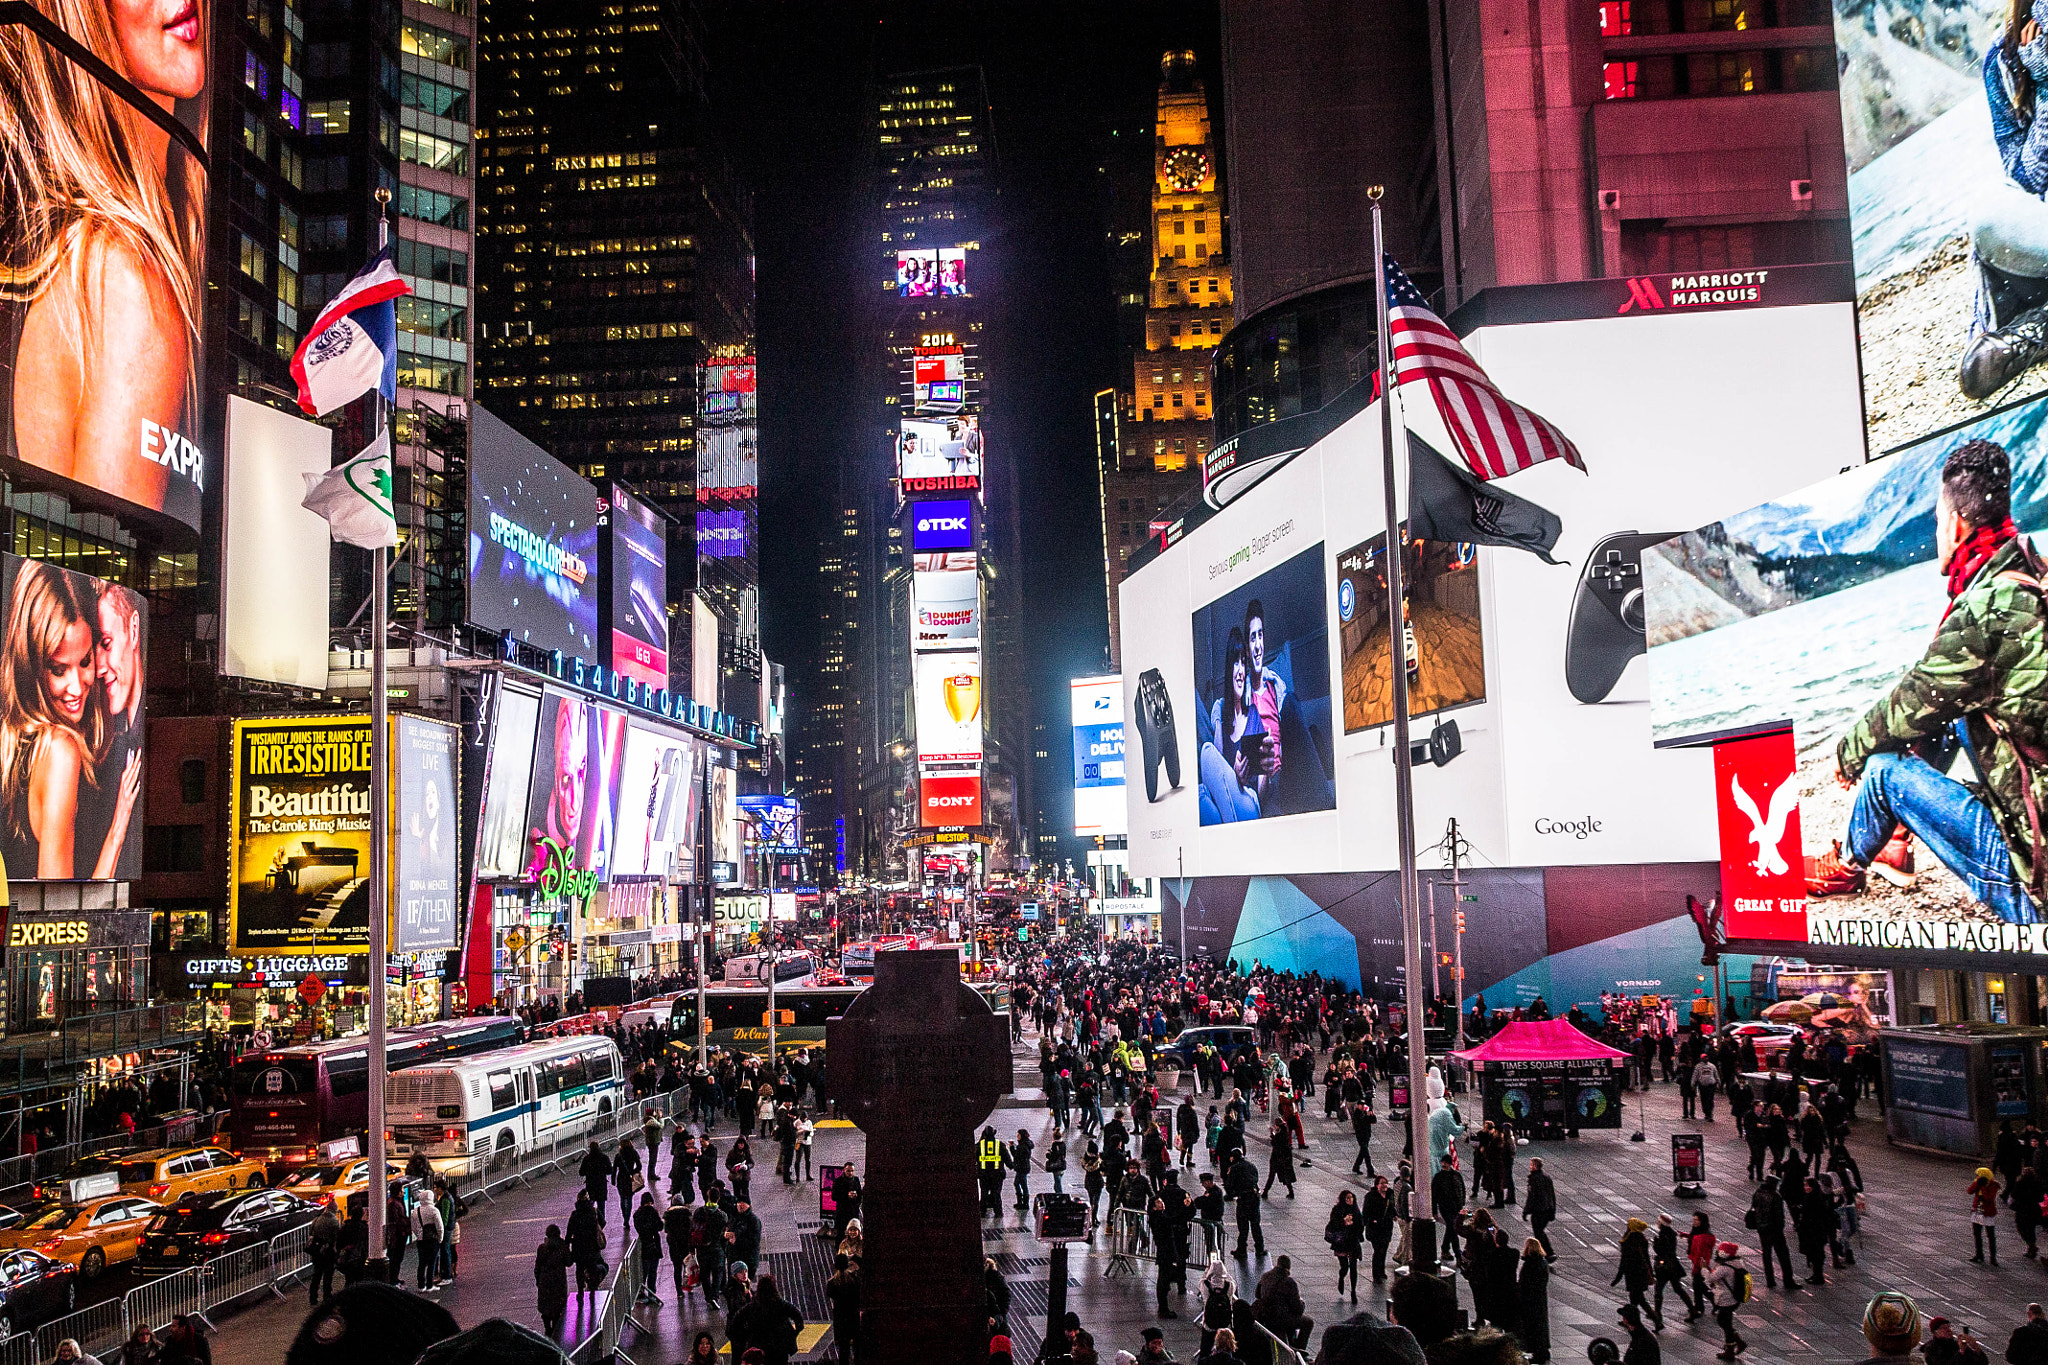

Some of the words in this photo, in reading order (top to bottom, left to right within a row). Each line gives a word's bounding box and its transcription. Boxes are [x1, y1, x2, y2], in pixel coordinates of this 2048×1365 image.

[1671, 271, 1768, 290] MARRIOTT
[1672, 287, 1758, 305] MARQUIS
[922, 334, 954, 347] 2014
[914, 345, 963, 356] TOSHIBA
[141, 417, 204, 493] EXPR
[1207, 438, 1240, 465] MARRIOTT
[1208, 453, 1236, 478] MARQUIS
[903, 475, 979, 492] TOSHIBA
[596, 515, 607, 526] G
[928, 517, 967, 531] TDK
[490, 511, 562, 576] SPECTACOLOR
[1208, 558, 1228, 580] Serious
[1251, 536, 1271, 555] Bigger
[933, 609, 973, 619] DUNKIN'
[933, 616, 971, 626] DONUTS
[554, 648, 619, 697] 1540
[627, 676, 735, 737] BROADWAY
[290, 732, 312, 744] JOINS
[313, 731, 327, 743] THE
[328, 730, 353, 743] RANKS
[355, 730, 365, 742] OF
[408, 726, 418, 736] SEE
[420, 728, 452, 742] BROADWAY'S
[412, 739, 435, 751] BIGGEST
[436, 742, 448, 753] STAR
[250, 741, 372, 774] IRRESISTIBLE
[422, 752, 439, 771] LIVE
[928, 796, 975, 807] SONY
[250, 820, 271, 833] The
[272, 819, 307, 832] Carole
[308, 818, 335, 834] King
[1535, 815, 1602, 839] Google
[427, 879, 448, 890] MENZEL
[607, 882, 654, 919] FOREVER
[1734, 897, 1773, 912] GREAT
[407, 895, 452, 928] IF/THEN
[10, 921, 88, 946] EXPRESS
[1811, 919, 1935, 949] AMERICAN
[1945, 921, 2032, 951] EAGLE
[1374, 938, 1395, 946] CHANGE
[186, 959, 242, 974] GIFTS
[256, 956, 348, 973] LUGGAGE
[265, 972, 282, 981] NY
[269, 980, 295, 988] SONY
[1501, 1061, 1528, 1070] TIMES
[1530, 1060, 1565, 1069] SQUARE
[1567, 1059, 1607, 1068] ALLIANCE
